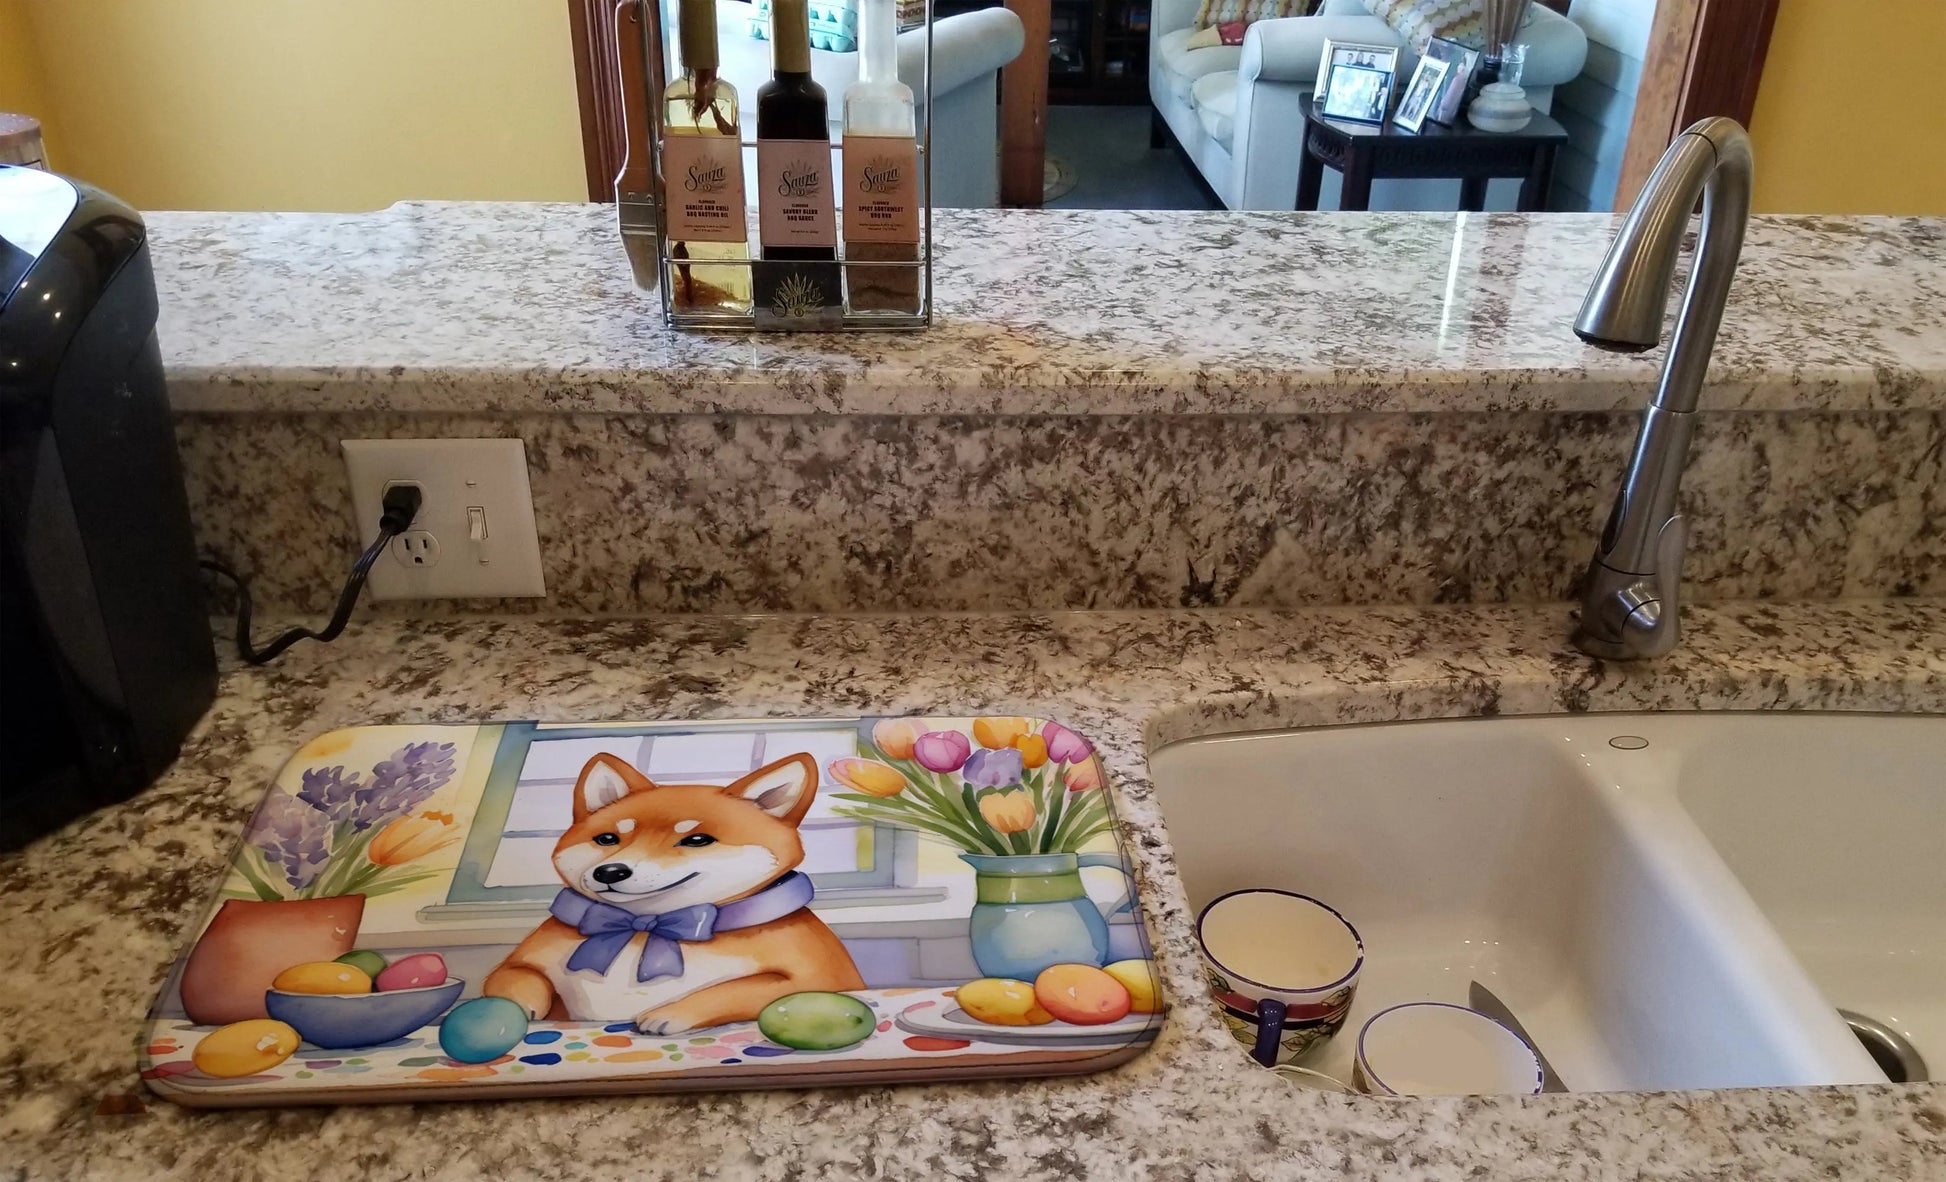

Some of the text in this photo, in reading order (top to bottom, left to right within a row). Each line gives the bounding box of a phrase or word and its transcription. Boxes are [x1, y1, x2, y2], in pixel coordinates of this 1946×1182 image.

[685, 166, 726, 191] Sauza
[778, 170, 818, 197] Sauza
[860, 166, 899, 192] Sauza
[771, 286, 824, 318] Sauza
